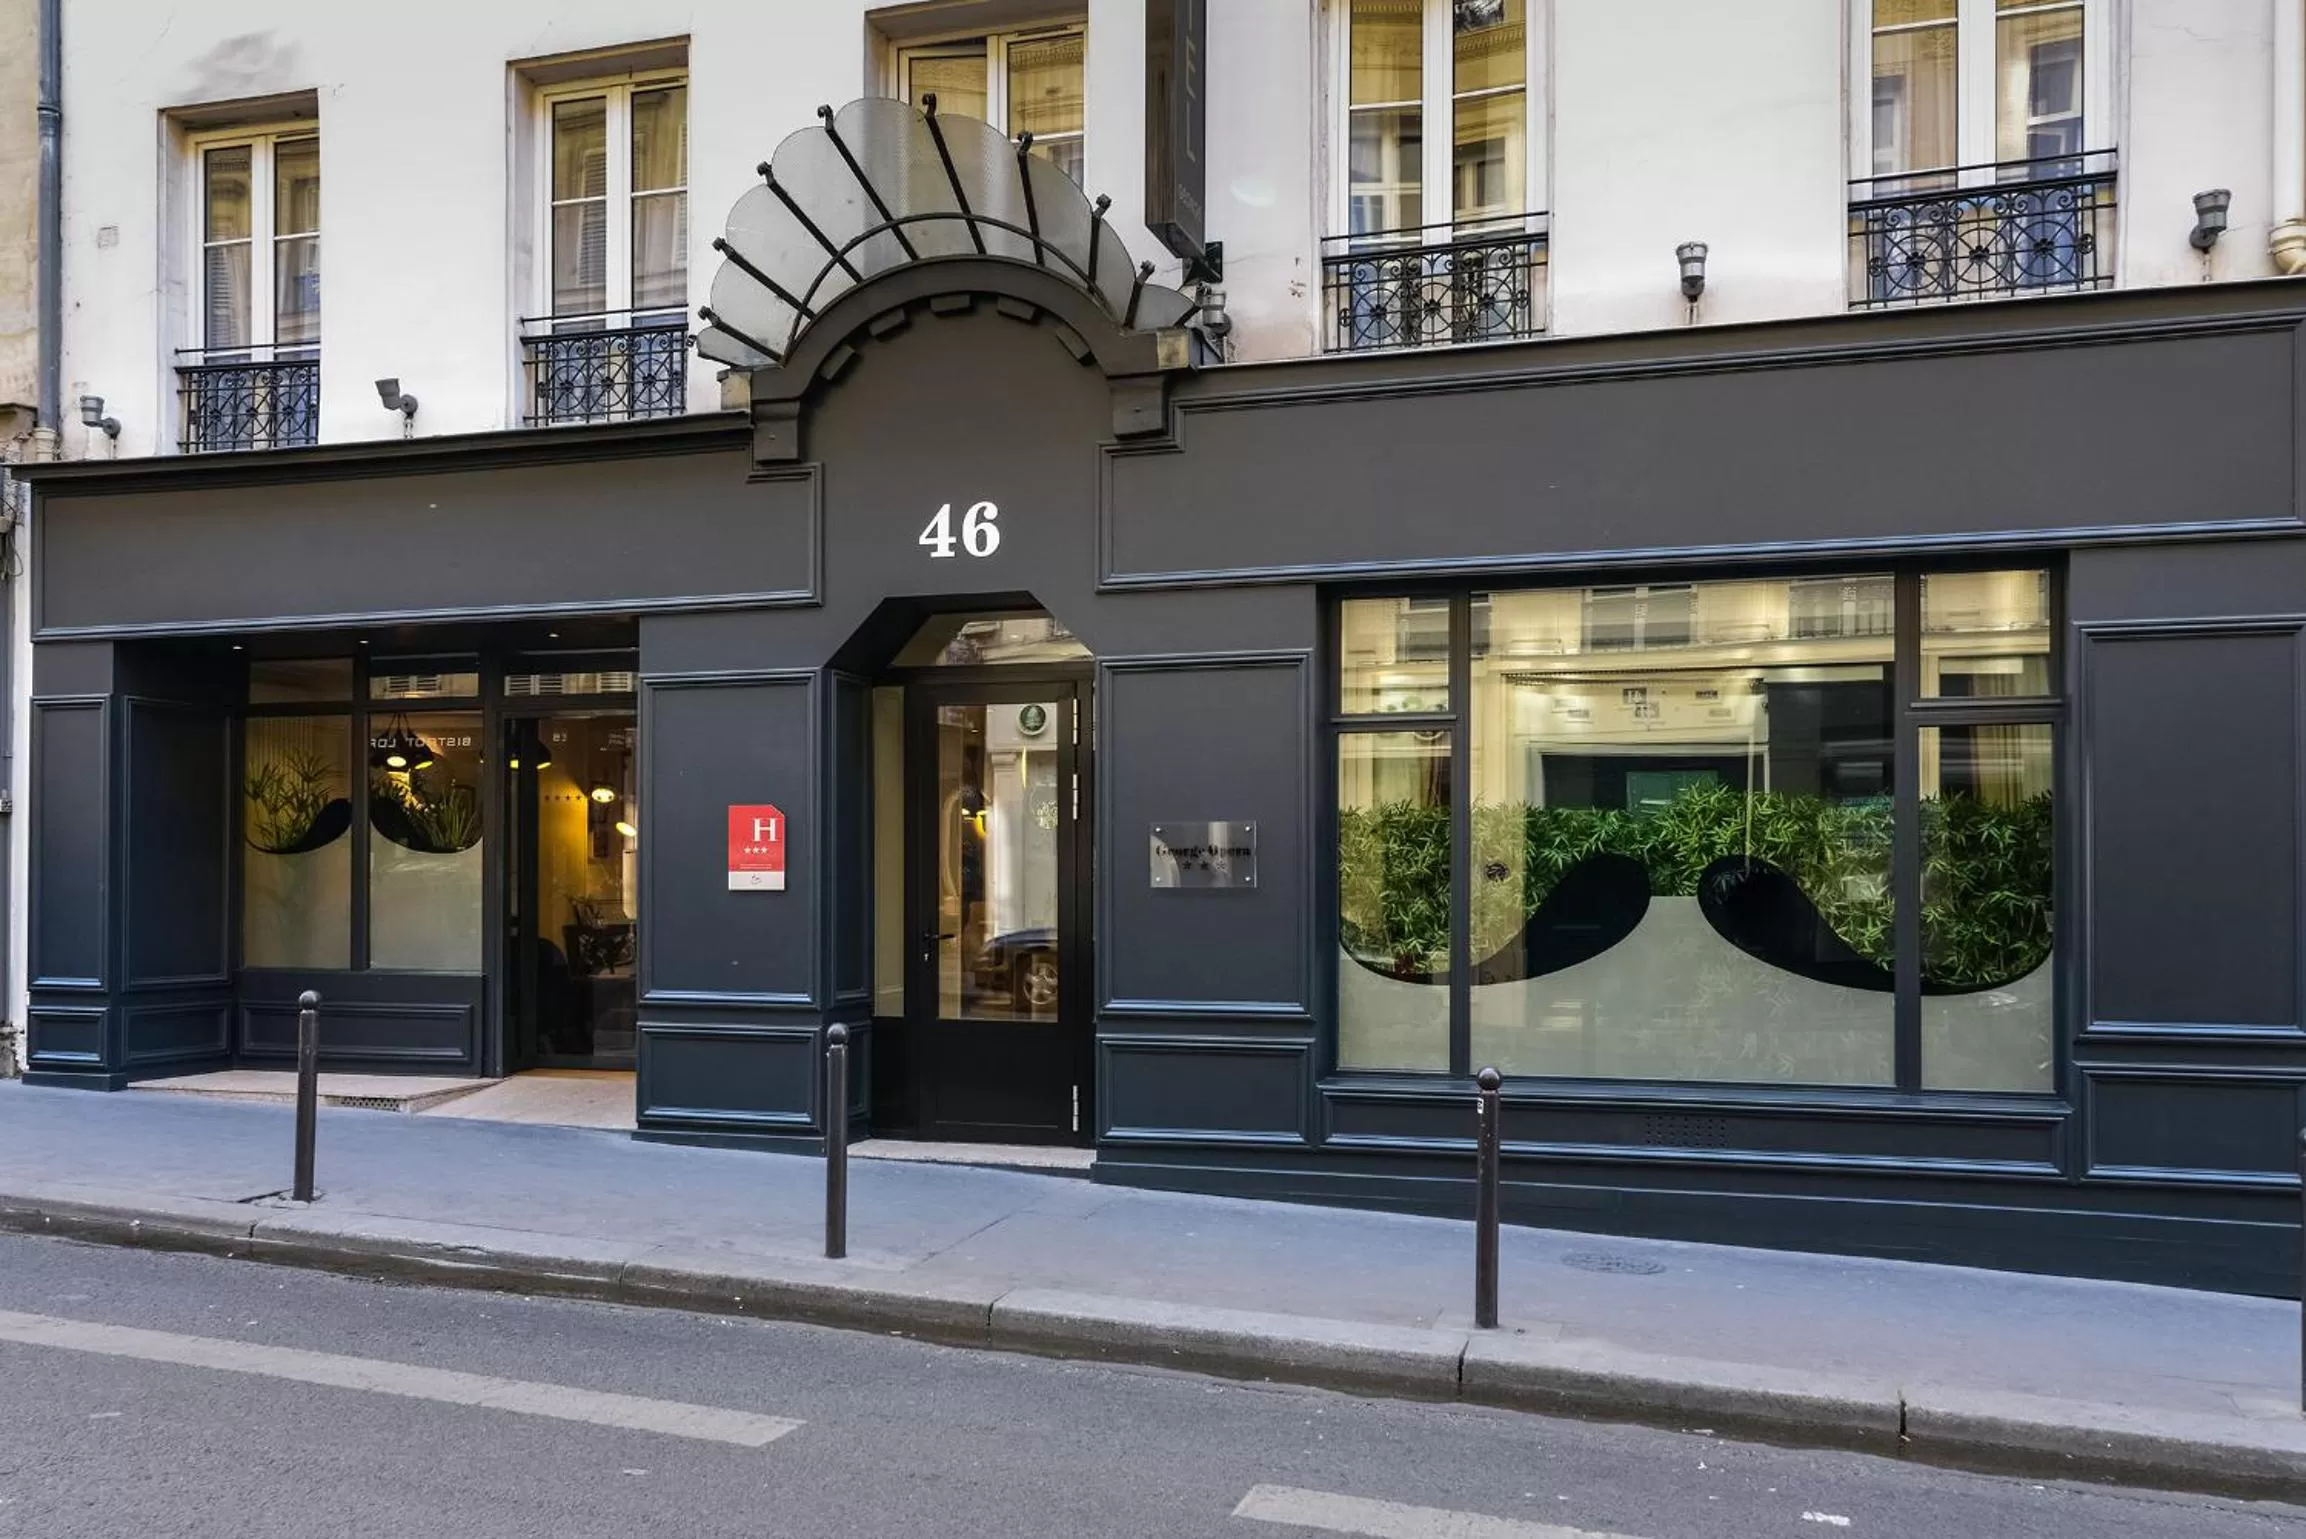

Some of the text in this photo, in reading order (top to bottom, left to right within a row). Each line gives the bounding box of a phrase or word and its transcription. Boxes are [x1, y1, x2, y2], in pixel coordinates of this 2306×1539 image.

[918, 500, 1000, 558] 46
[753, 818, 777, 842] H
[1155, 843, 1205, 859] George
